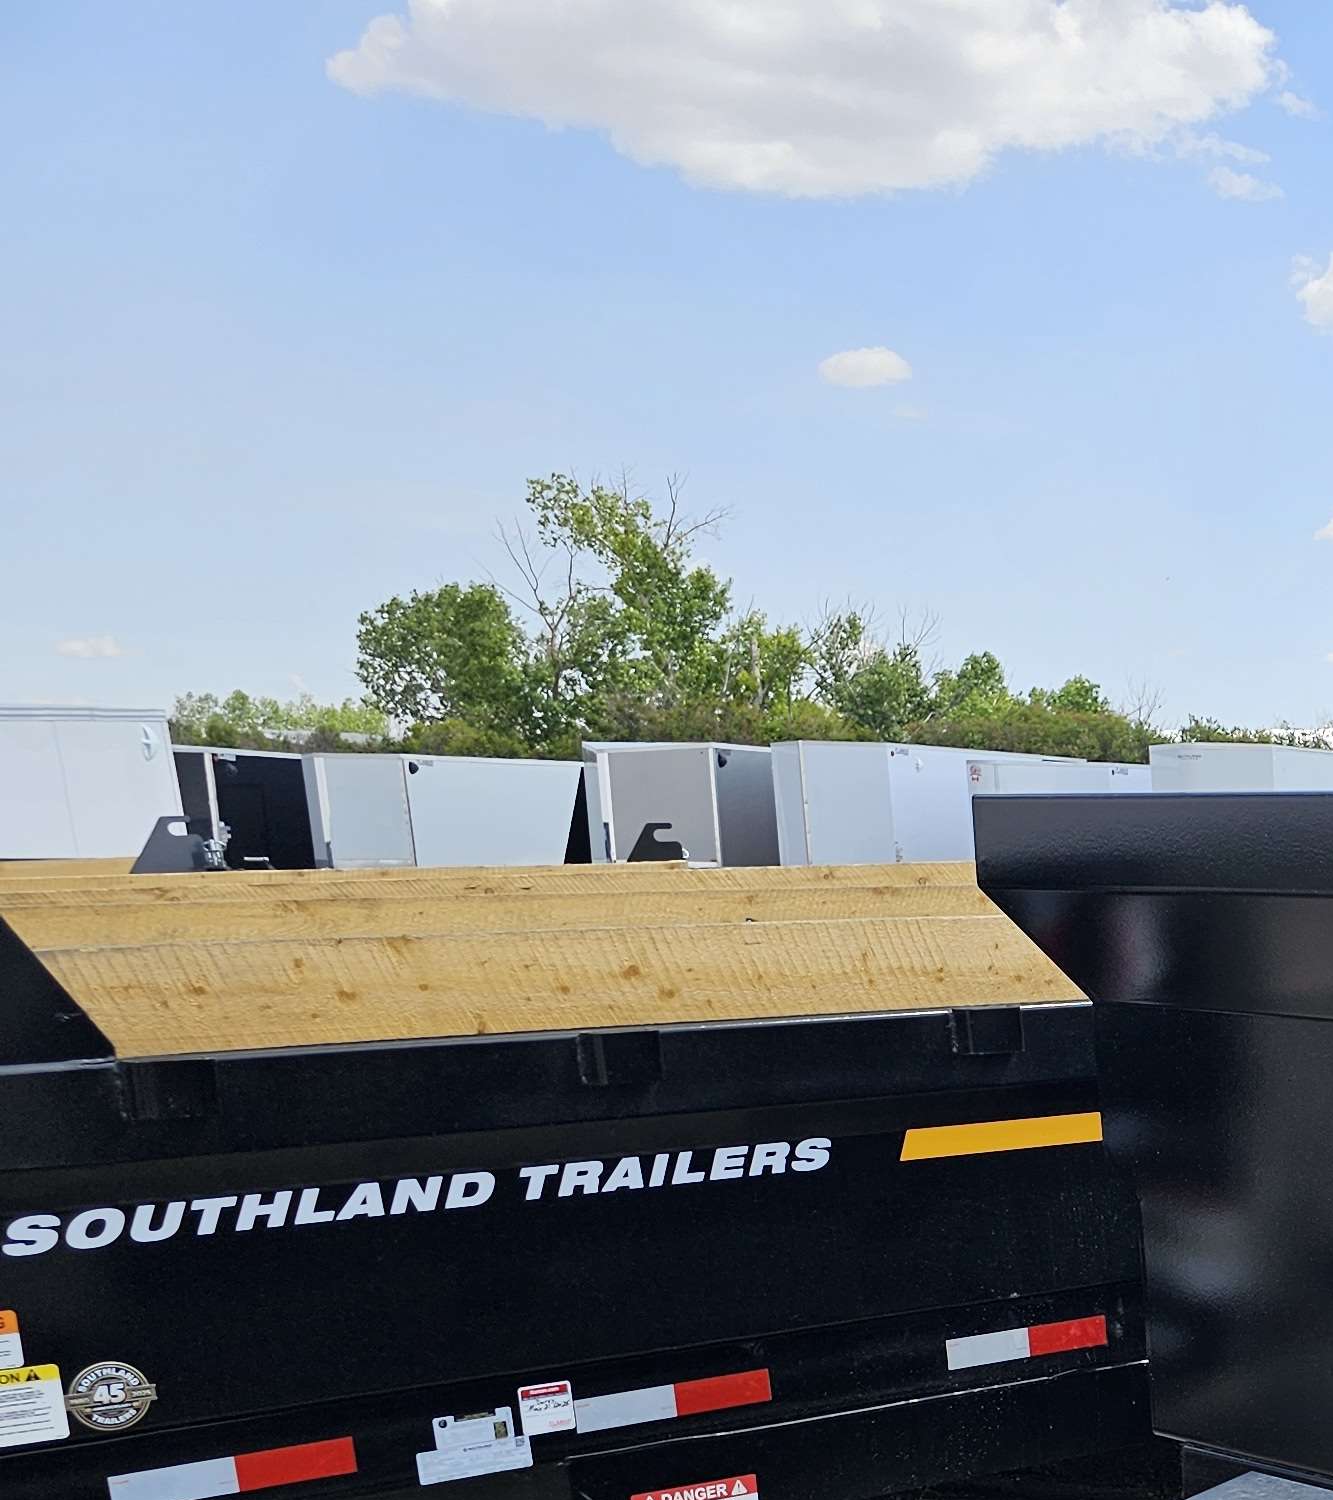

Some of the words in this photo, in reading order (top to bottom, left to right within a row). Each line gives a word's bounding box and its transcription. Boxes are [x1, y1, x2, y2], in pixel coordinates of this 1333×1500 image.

[2, 1170, 495, 1257] SOUTHLAND
[519, 1136, 833, 1202] TRAILERS
[77, 1367, 140, 1393] SOUTHLAND
[93, 1383, 126, 1405] 45
[91, 1408, 137, 1425] TRAILERS
